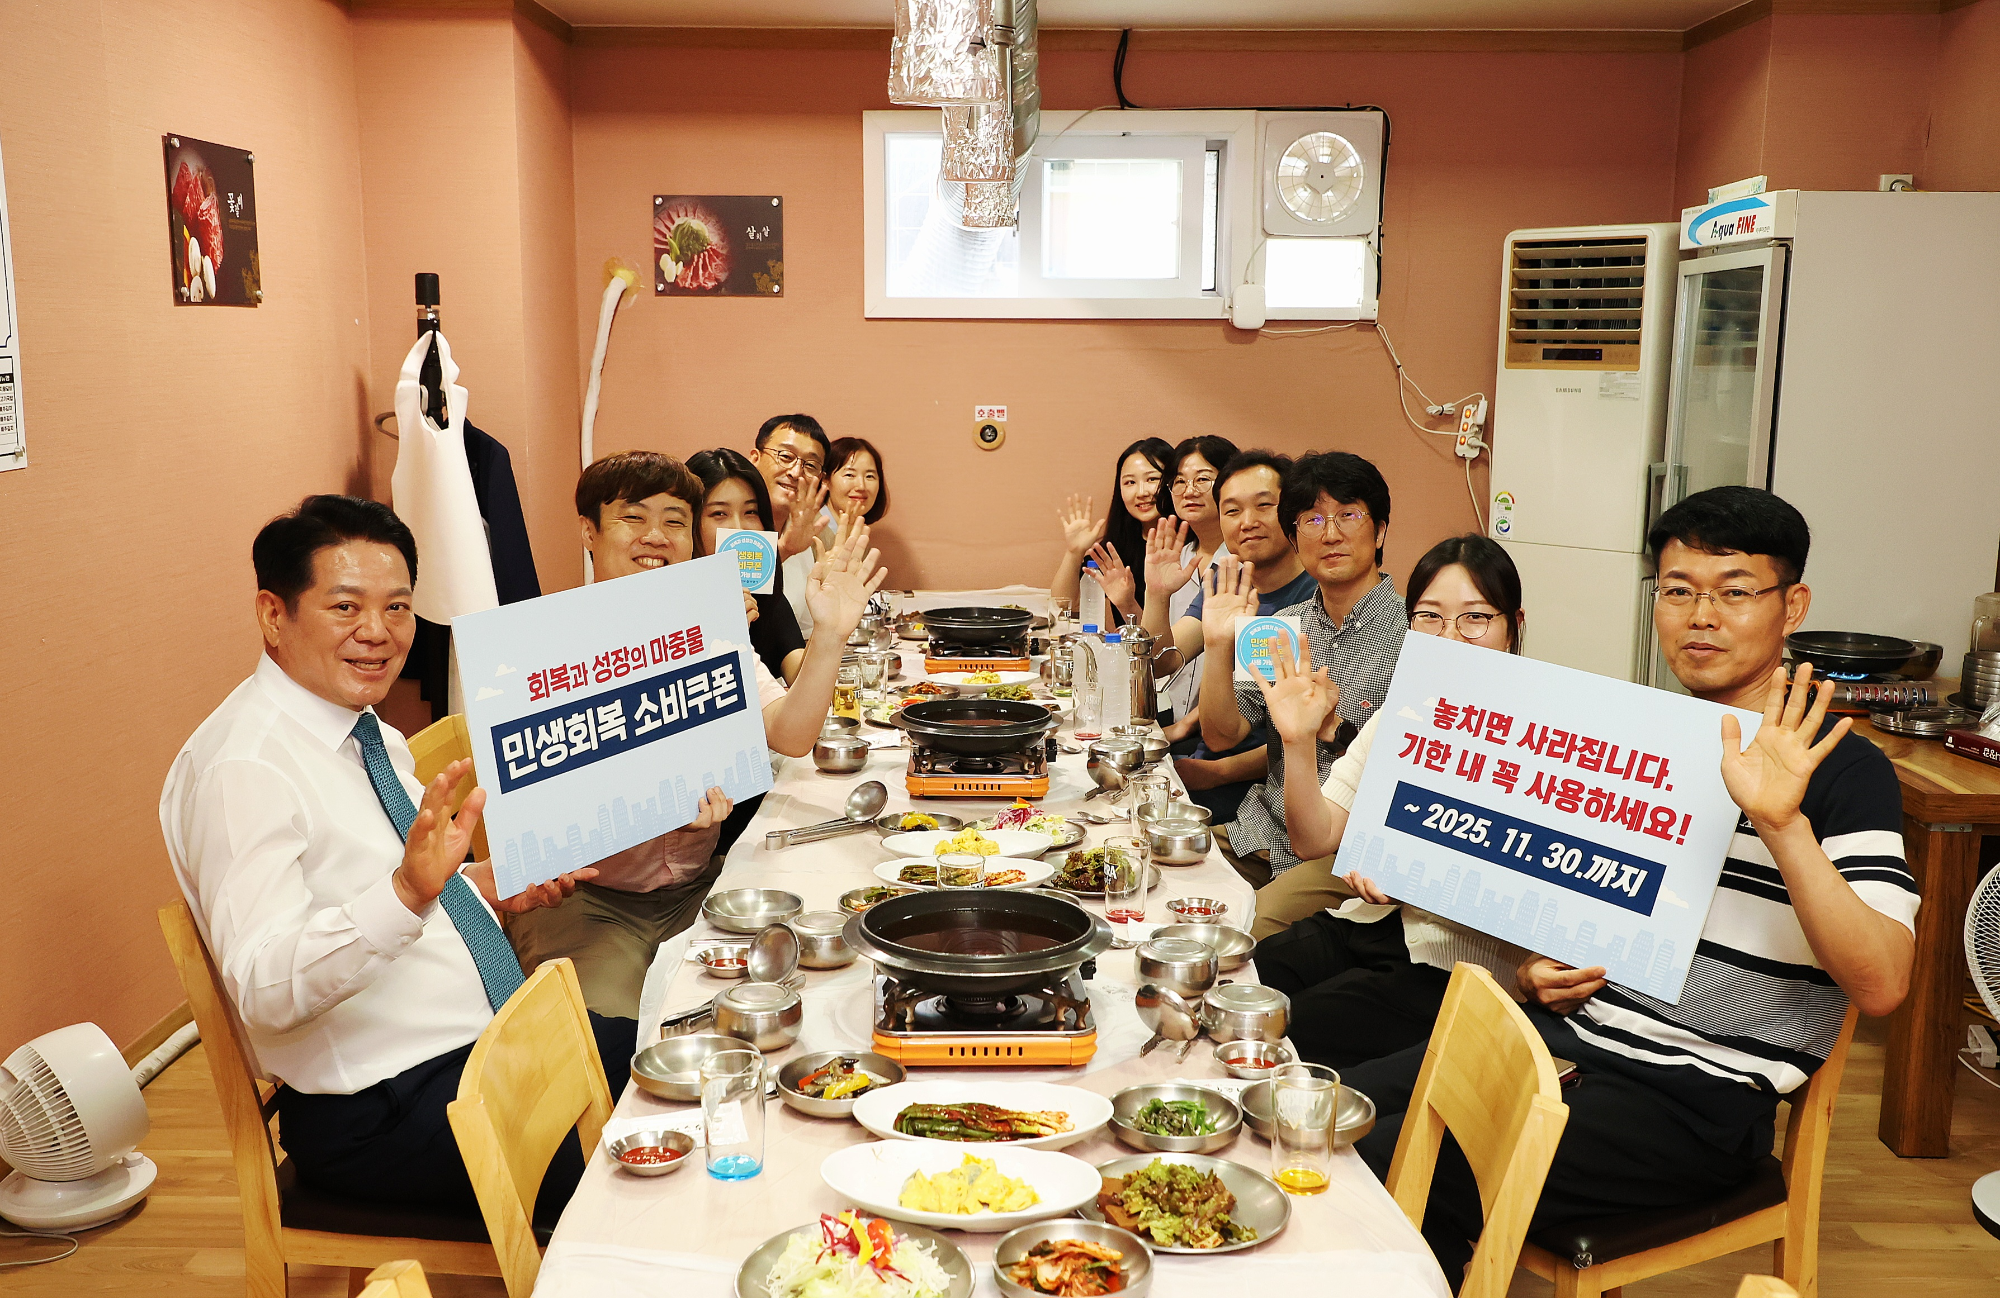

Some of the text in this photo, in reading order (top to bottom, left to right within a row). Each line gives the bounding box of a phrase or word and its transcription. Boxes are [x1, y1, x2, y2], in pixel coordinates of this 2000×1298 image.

[1711, 215, 1756, 240] Aqua FINE
[977, 409, 1005, 418] 호출벨
[527, 625, 705, 702] 회복과 성장의 마중물
[501, 664, 738, 780] 민생회복 소비쿠폰
[1433, 697, 1674, 792] 놓치면 사라집니다.
[1398, 732, 1693, 846] 기한 내 꼭 사용하세요!
[1422, 803, 1492, 848] 2025.
[1500, 827, 1534, 862] 11.
[1541, 842, 1649, 898] 30.까지
